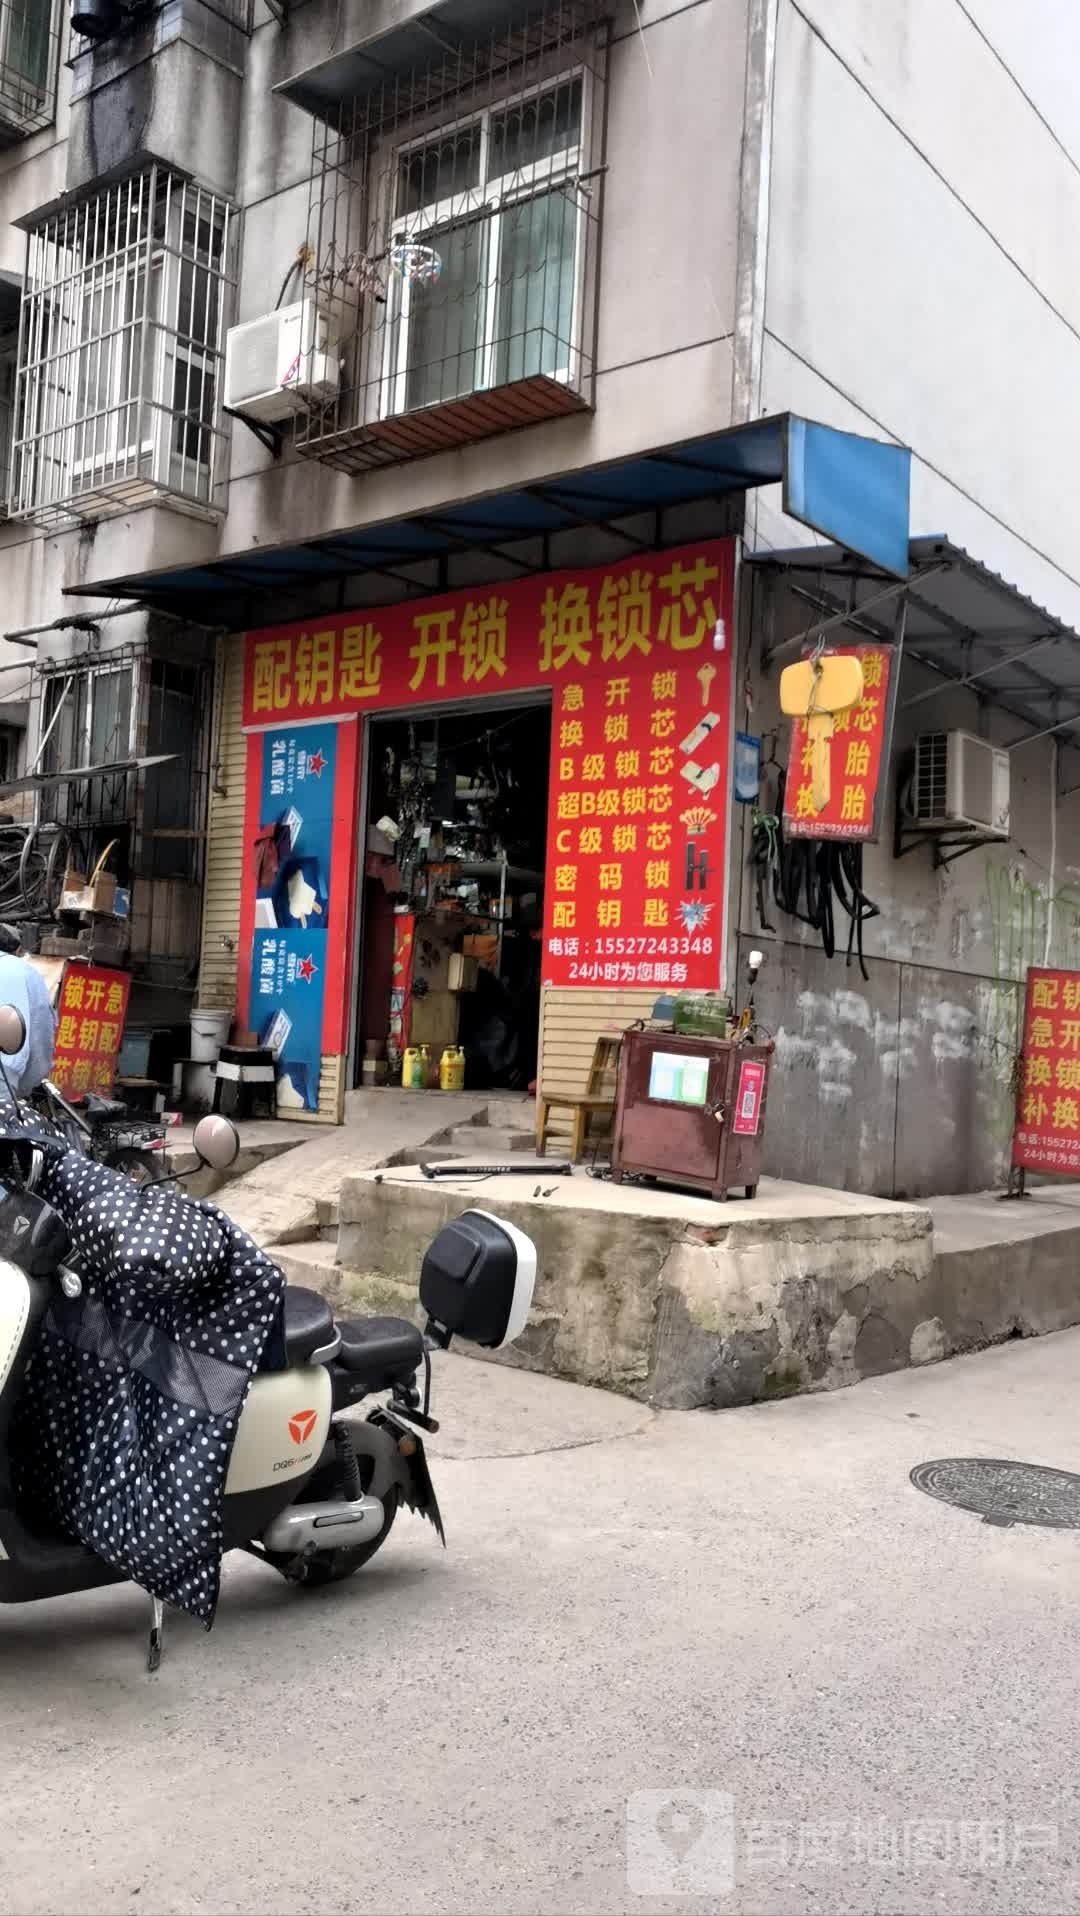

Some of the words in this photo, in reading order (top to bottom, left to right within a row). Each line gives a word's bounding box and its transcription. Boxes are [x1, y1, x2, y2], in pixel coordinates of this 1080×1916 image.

[252, 622, 383, 713] 配钥匙
[408, 597, 509, 691] 开锁
[538, 558, 719, 673] 换锁芯
[561, 671, 678, 711] 急开锁
[559, 708, 678, 749] 换锁芯
[559, 746, 675, 781] B级锁芯
[557, 786, 673, 820] 超B级锁芯
[556, 821, 672, 855] C级锁芯
[554, 860, 670, 892] 密码锁
[552, 898, 669, 930] 配钥匙
[569, 962, 689, 983] 24小时为您服务
